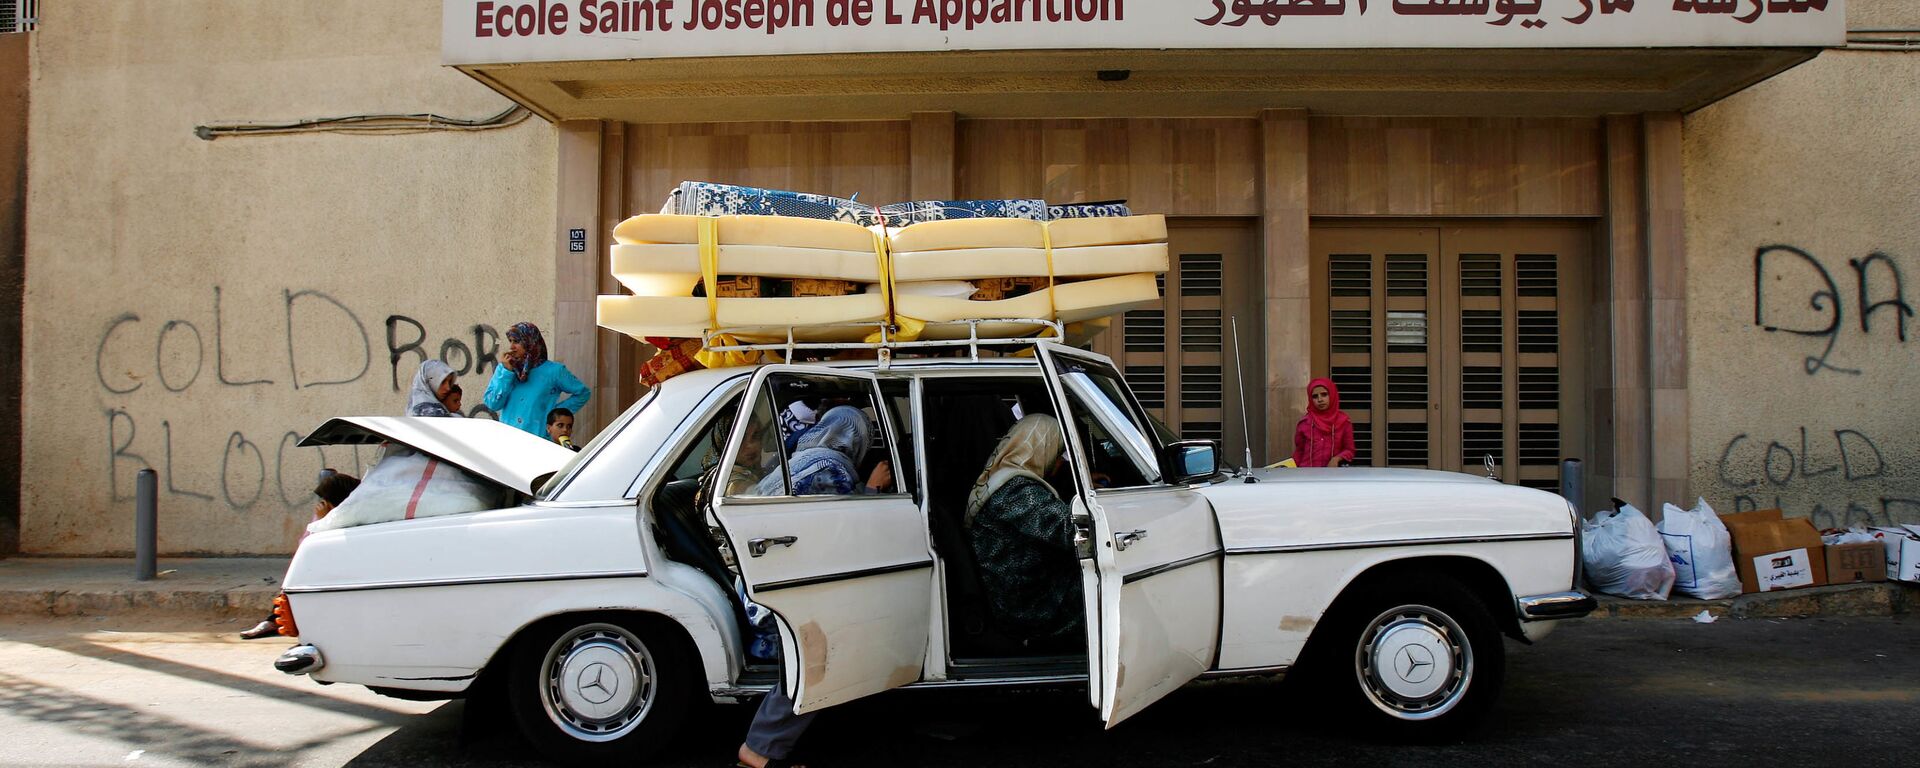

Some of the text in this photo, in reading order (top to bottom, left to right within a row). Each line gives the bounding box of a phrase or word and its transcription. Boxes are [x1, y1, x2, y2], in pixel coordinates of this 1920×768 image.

[579, 0, 674, 34] Saint
[683, 0, 815, 35] Joseph
[826, 0, 874, 27] de
[570, 241, 584, 251] 156
[97, 286, 372, 395] COLD
[1719, 426, 1885, 489] COLD
